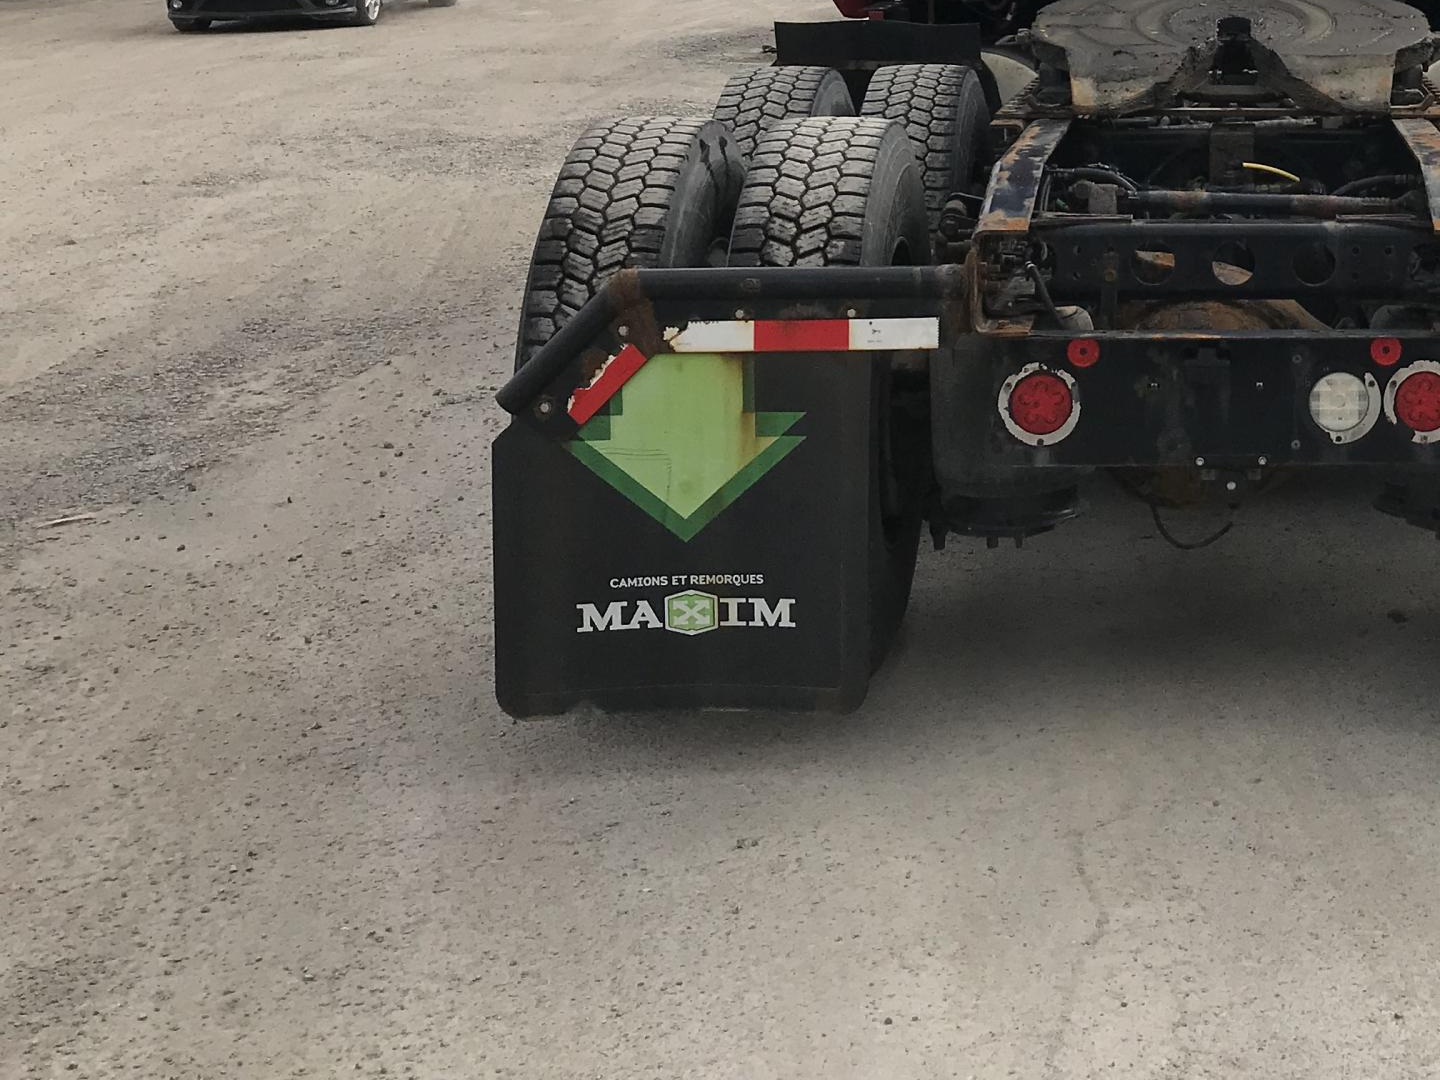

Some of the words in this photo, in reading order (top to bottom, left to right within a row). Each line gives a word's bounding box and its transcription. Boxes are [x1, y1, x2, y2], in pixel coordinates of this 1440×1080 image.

[610, 576, 668, 588] CAMIONS
[672, 575, 688, 585] ET
[690, 574, 764, 586] REMORQUES
[576, 590, 796, 635] MAXIM
